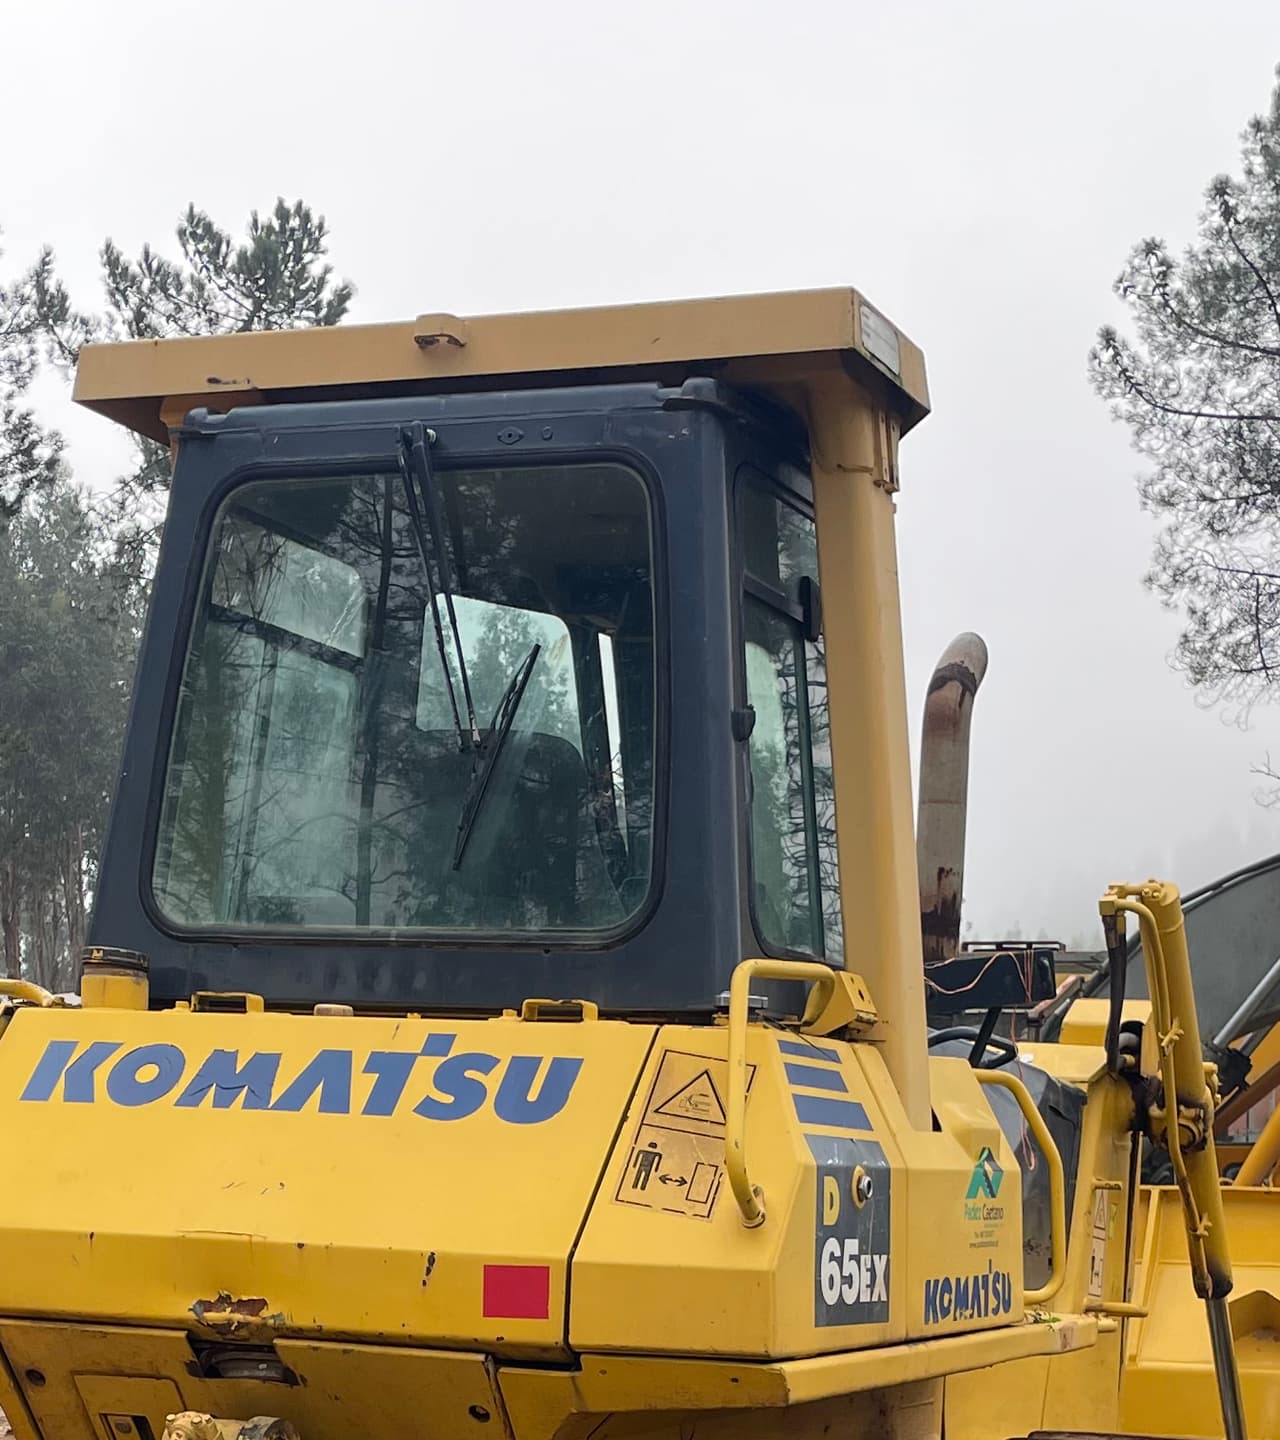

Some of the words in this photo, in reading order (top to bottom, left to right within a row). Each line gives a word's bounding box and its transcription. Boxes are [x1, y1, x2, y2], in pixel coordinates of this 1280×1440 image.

[19, 1033, 585, 1125] KOMATSU
[822, 1175, 841, 1226] D
[820, 1237, 889, 1306] 65EX
[923, 1258, 1012, 1326] KOMATSU
